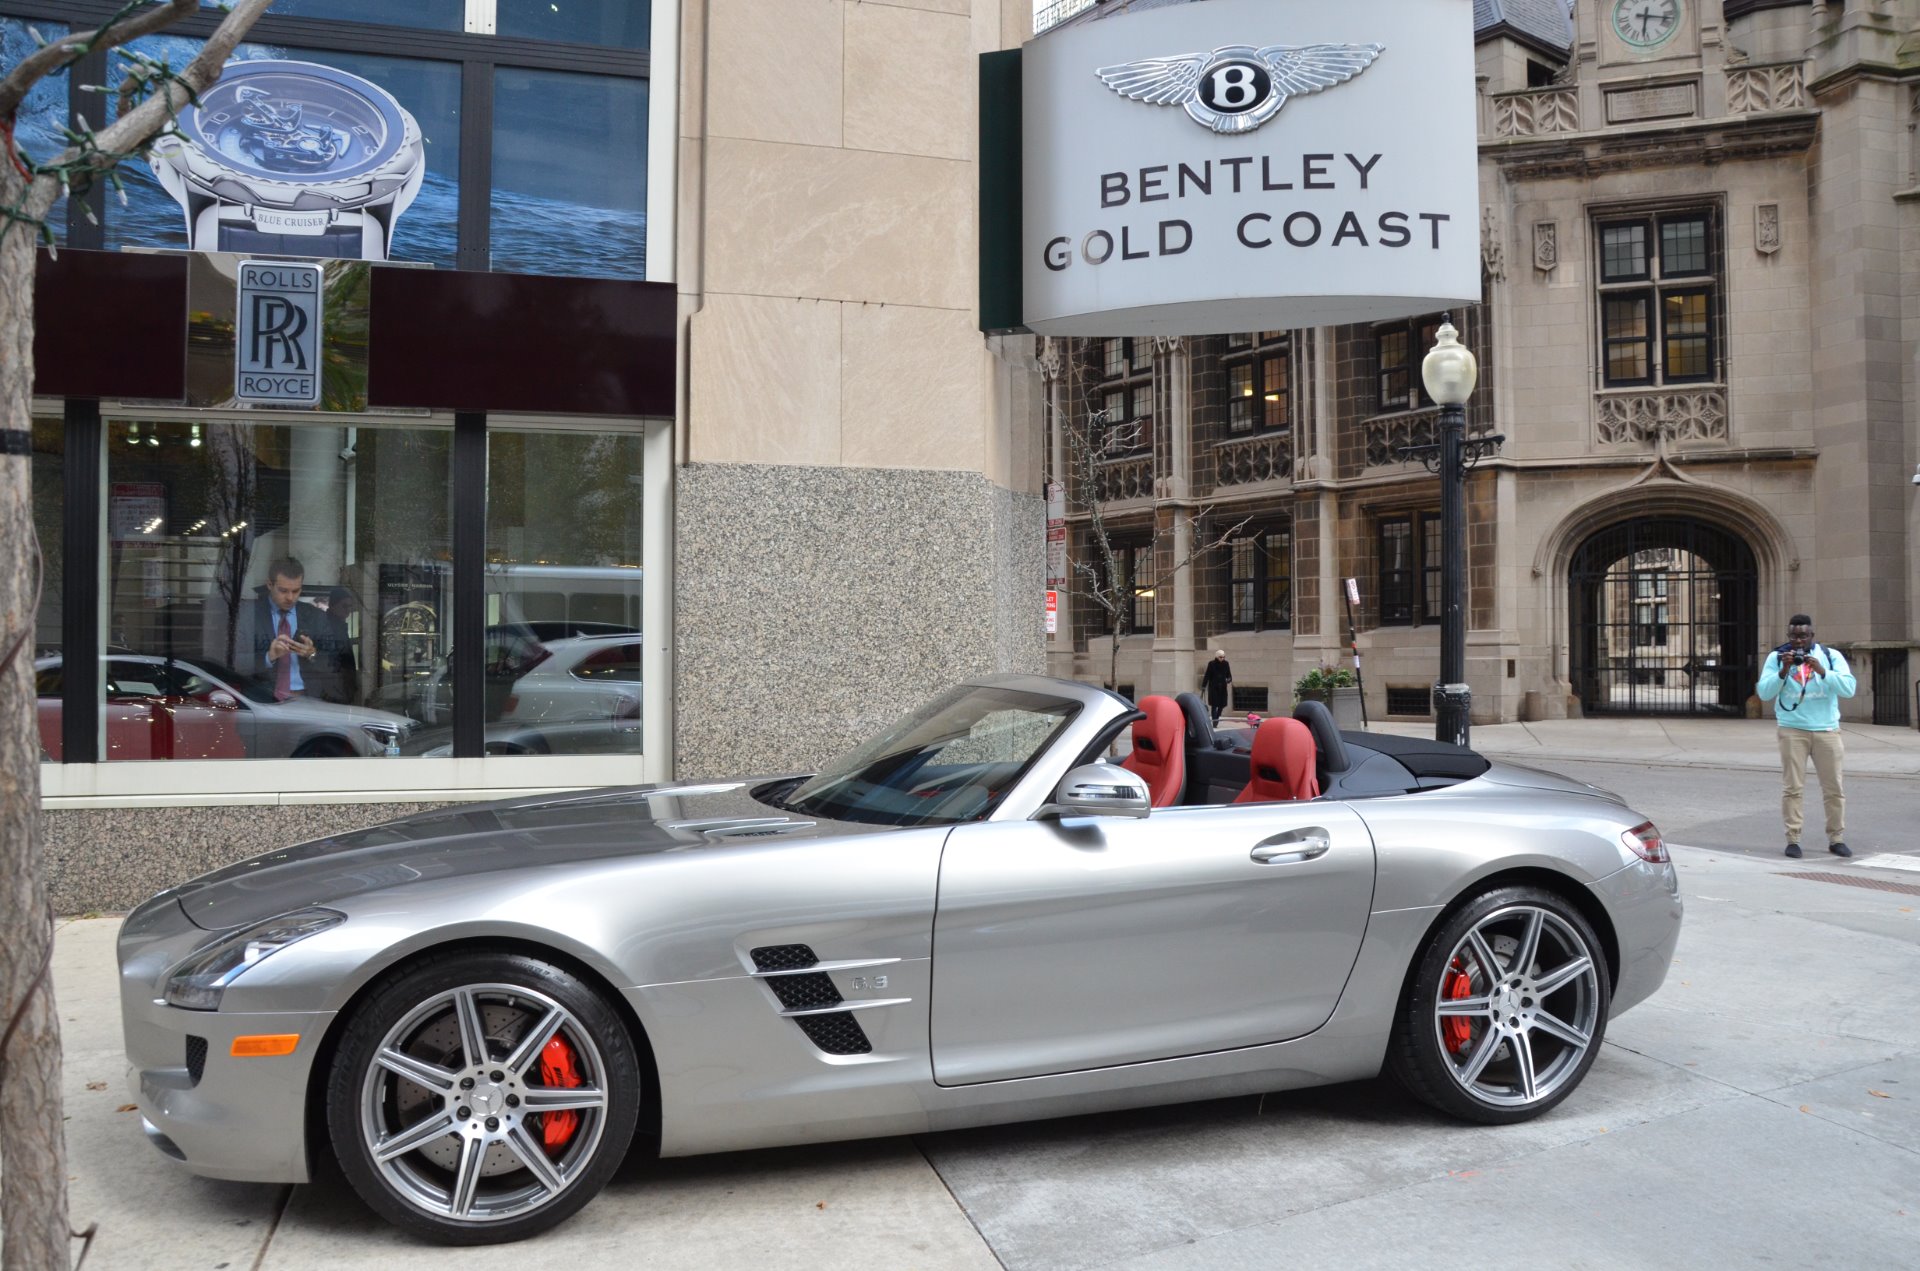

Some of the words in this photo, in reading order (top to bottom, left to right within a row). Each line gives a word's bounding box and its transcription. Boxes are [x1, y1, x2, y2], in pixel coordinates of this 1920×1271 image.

[1100, 153, 1383, 209] BENTLEY
[258, 213, 282, 225] BLUE
[284, 217, 325, 227] CRUISER
[1043, 219, 1193, 271] GOLD
[1236, 211, 1451, 249] COAST
[247, 270, 312, 288] ROLLS
[250, 294, 308, 370] RR
[244, 376, 310, 395] ROYCE
[851, 976, 888, 990] 6.3
